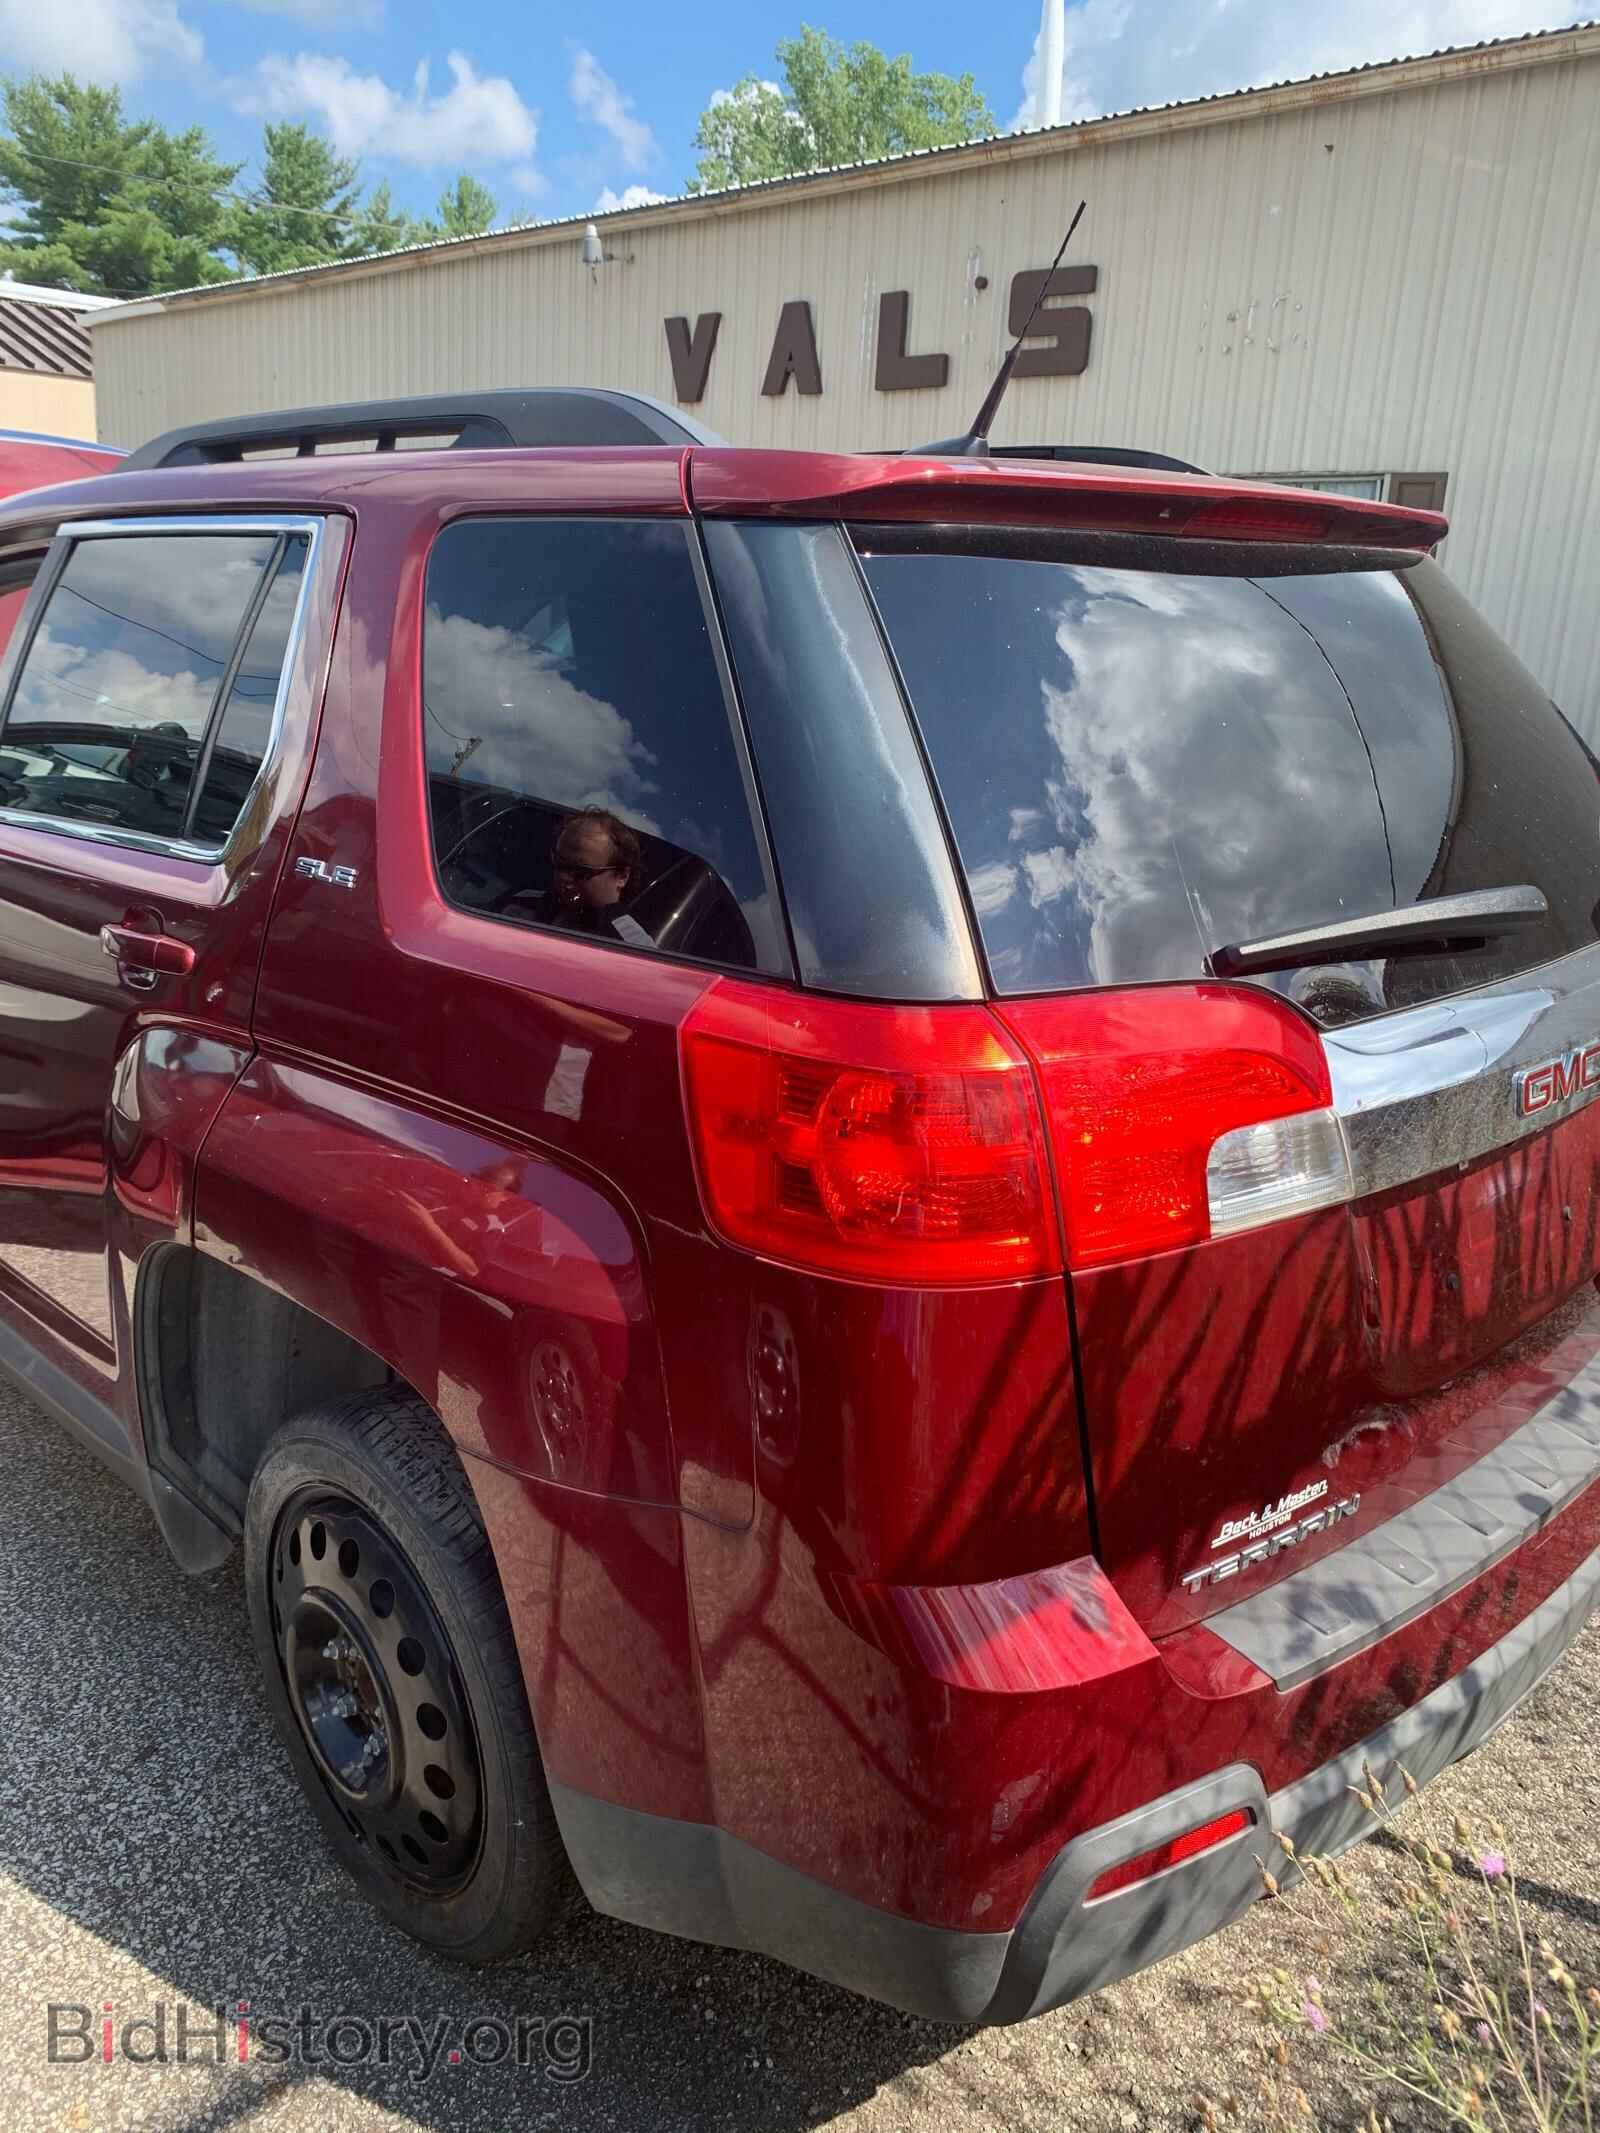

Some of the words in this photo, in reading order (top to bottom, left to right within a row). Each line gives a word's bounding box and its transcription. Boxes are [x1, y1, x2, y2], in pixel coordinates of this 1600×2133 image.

[664, 264, 1098, 403] VAL'S
[295, 856, 359, 891] SLE
[1519, 1042, 1600, 1116] GMC
[1181, 1493, 1361, 1594] TERRAIN
[1219, 1511, 1260, 1537] Beck
[1261, 1504, 1273, 1521] &
[1248, 1512, 1292, 1540] HOUSTON
